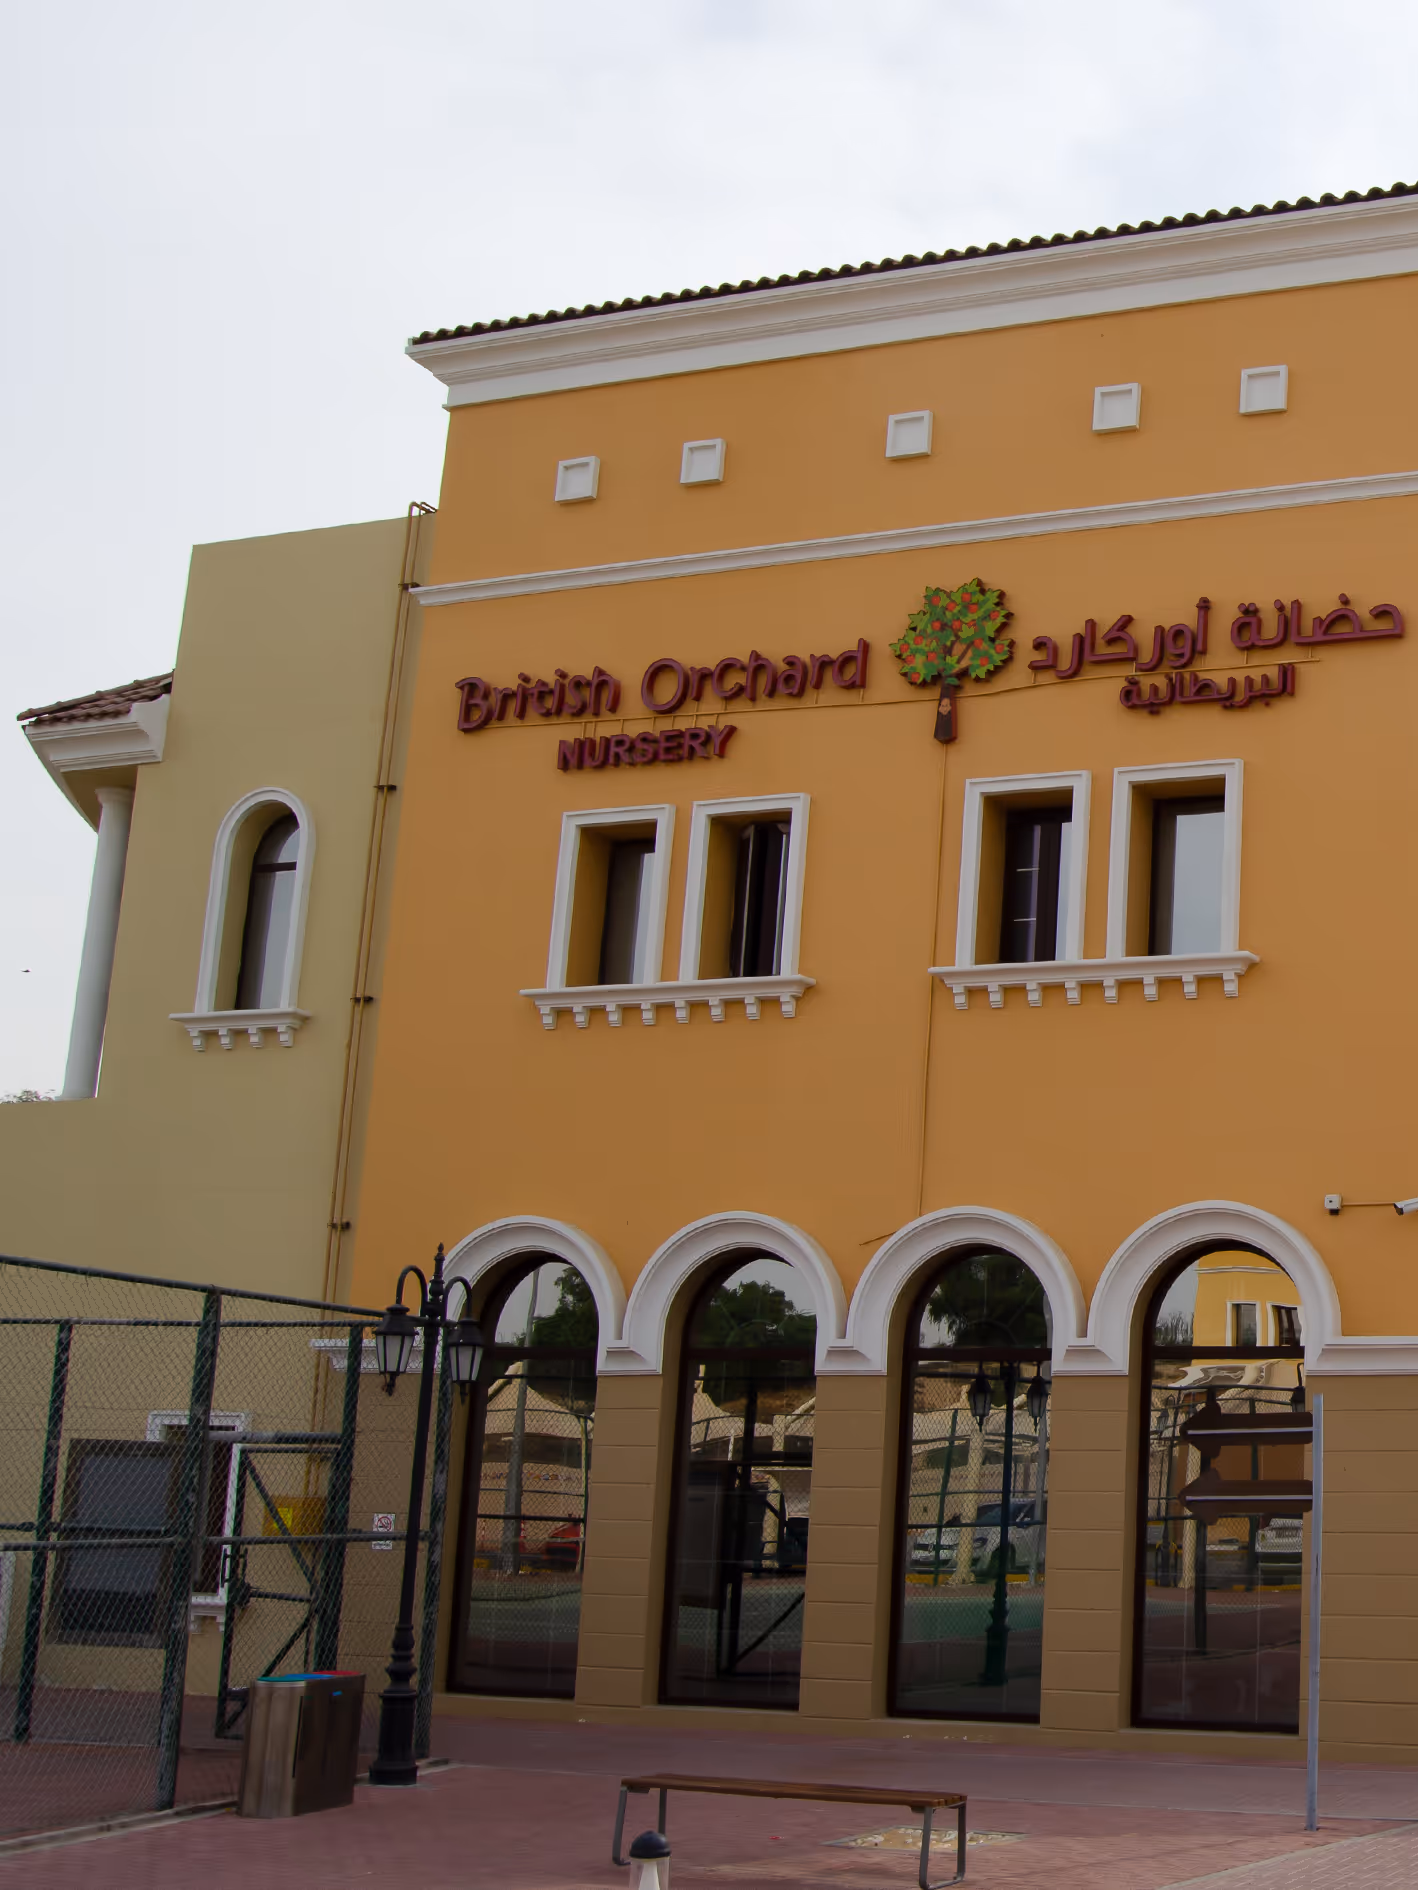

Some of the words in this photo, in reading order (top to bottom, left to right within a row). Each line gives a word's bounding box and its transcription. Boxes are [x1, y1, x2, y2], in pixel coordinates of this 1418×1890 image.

[1027, 596, 1212, 680] أوركارد
[1229, 593, 1405, 651] حضانة
[454, 666, 621, 735] British
[641, 637, 870, 714] Orchard
[1119, 662, 1297, 715] البريطانية
[556, 723, 738, 773] NURSERY
